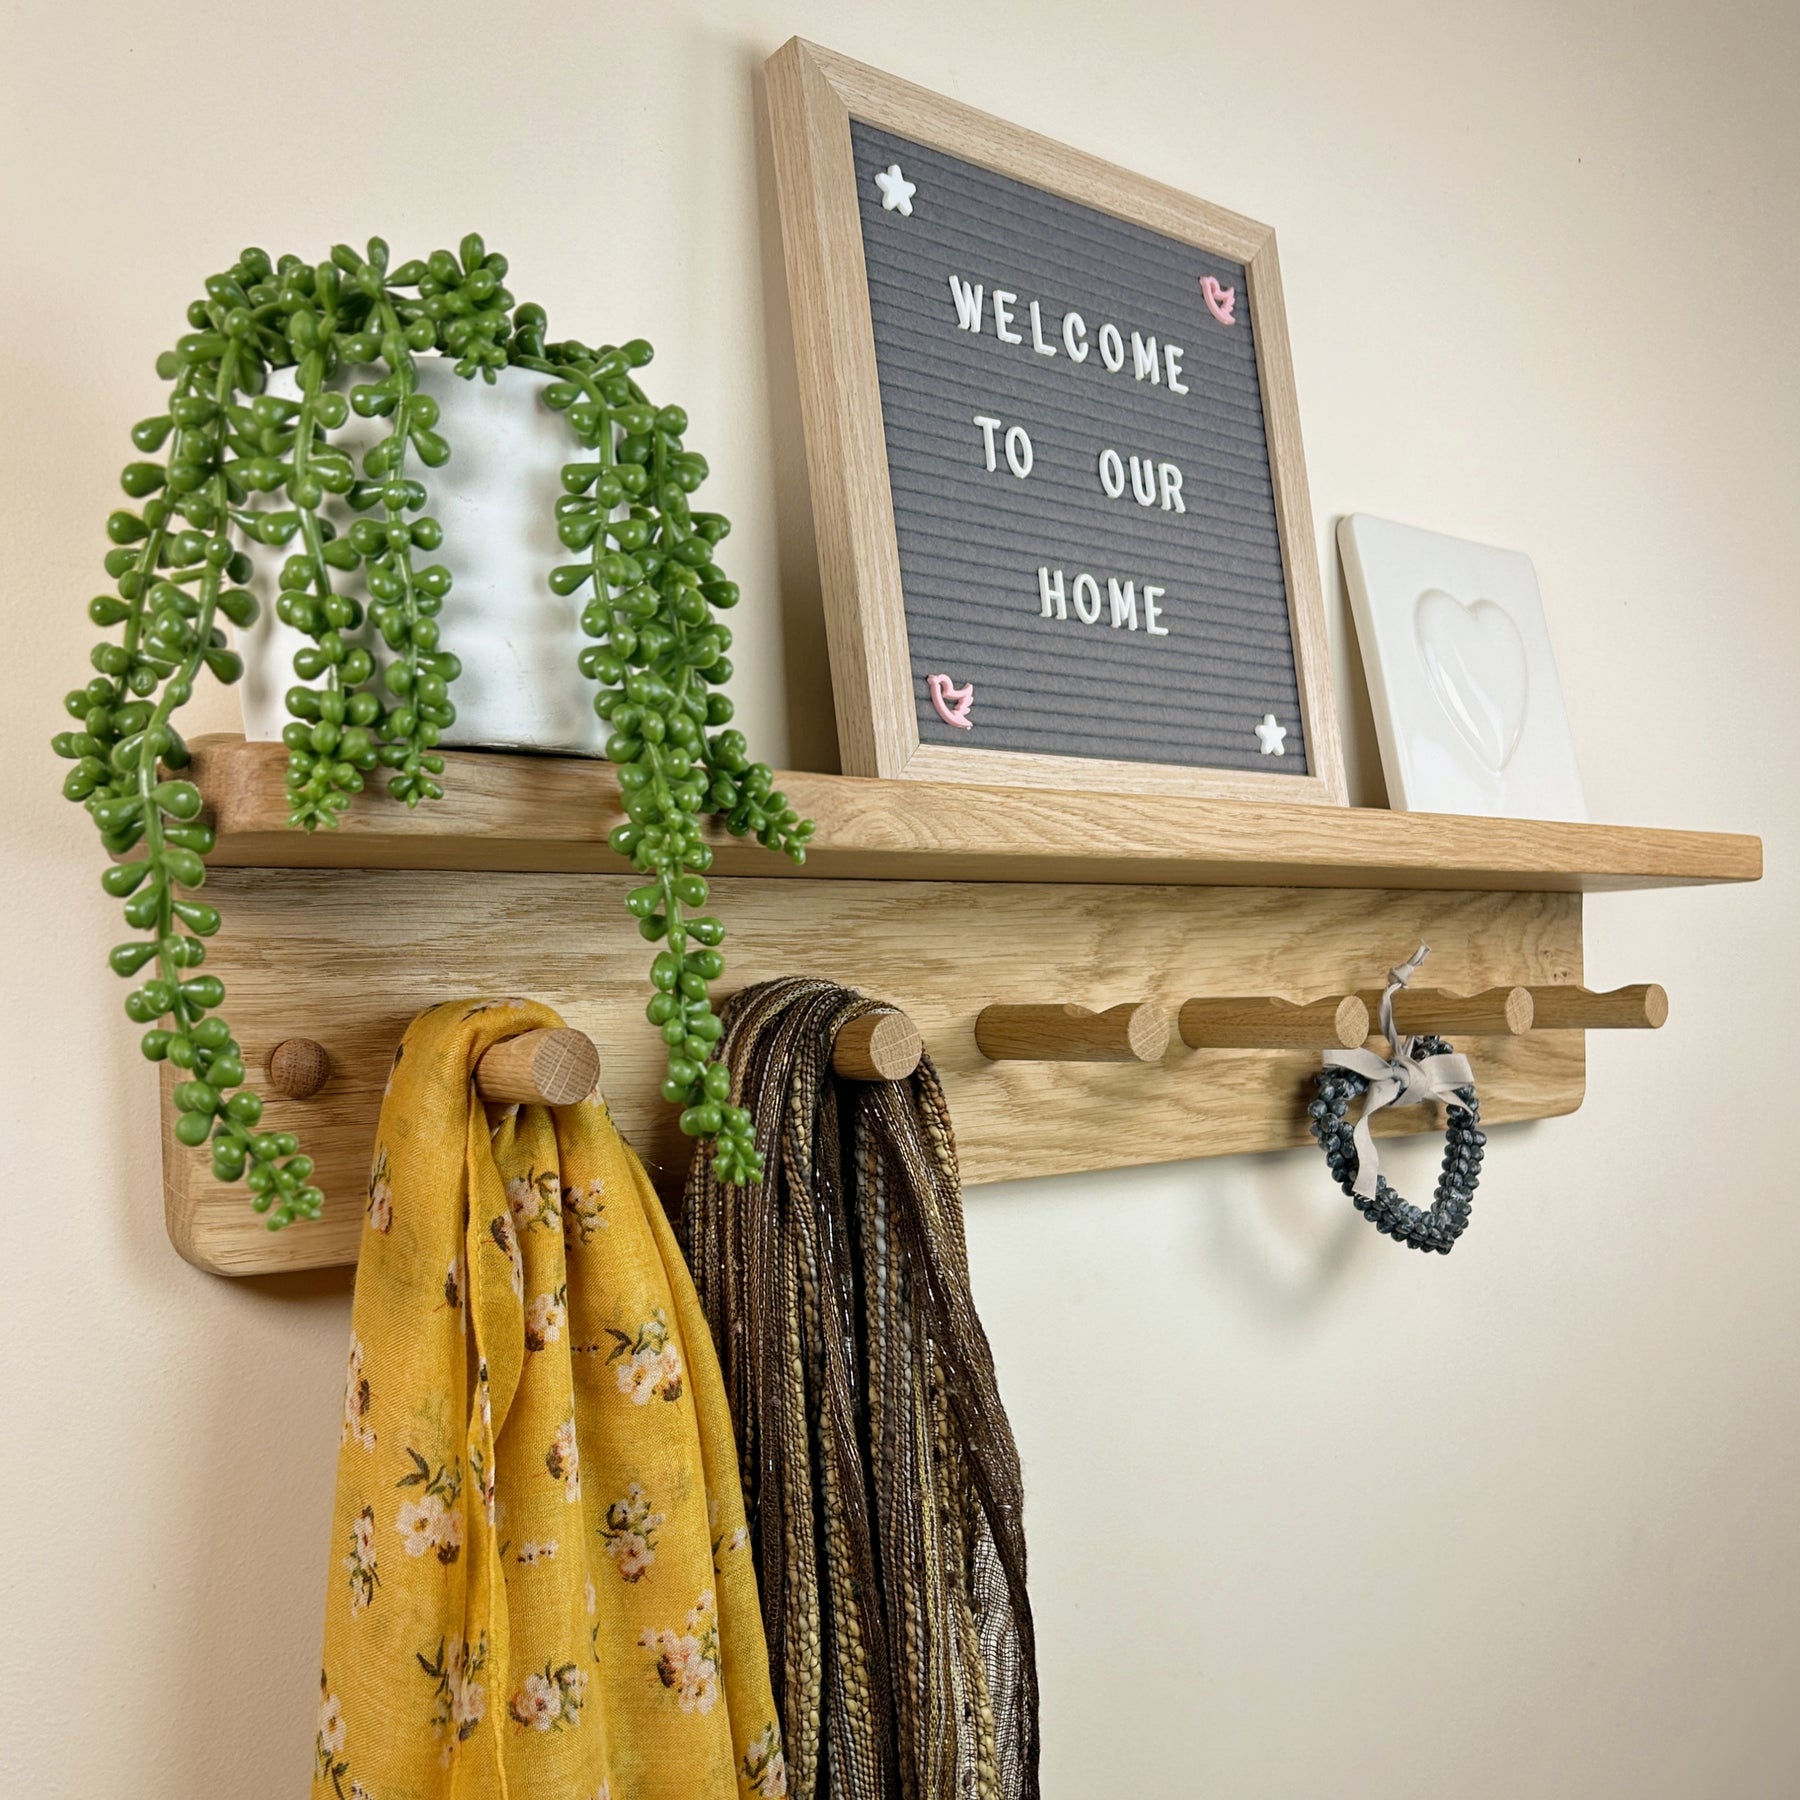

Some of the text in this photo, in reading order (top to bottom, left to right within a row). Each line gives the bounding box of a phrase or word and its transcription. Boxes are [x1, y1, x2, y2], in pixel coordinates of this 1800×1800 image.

[948, 275, 1189, 395] WELCOME
[973, 416, 1186, 513] TO OUR
[1038, 567, 1169, 636] HOME
